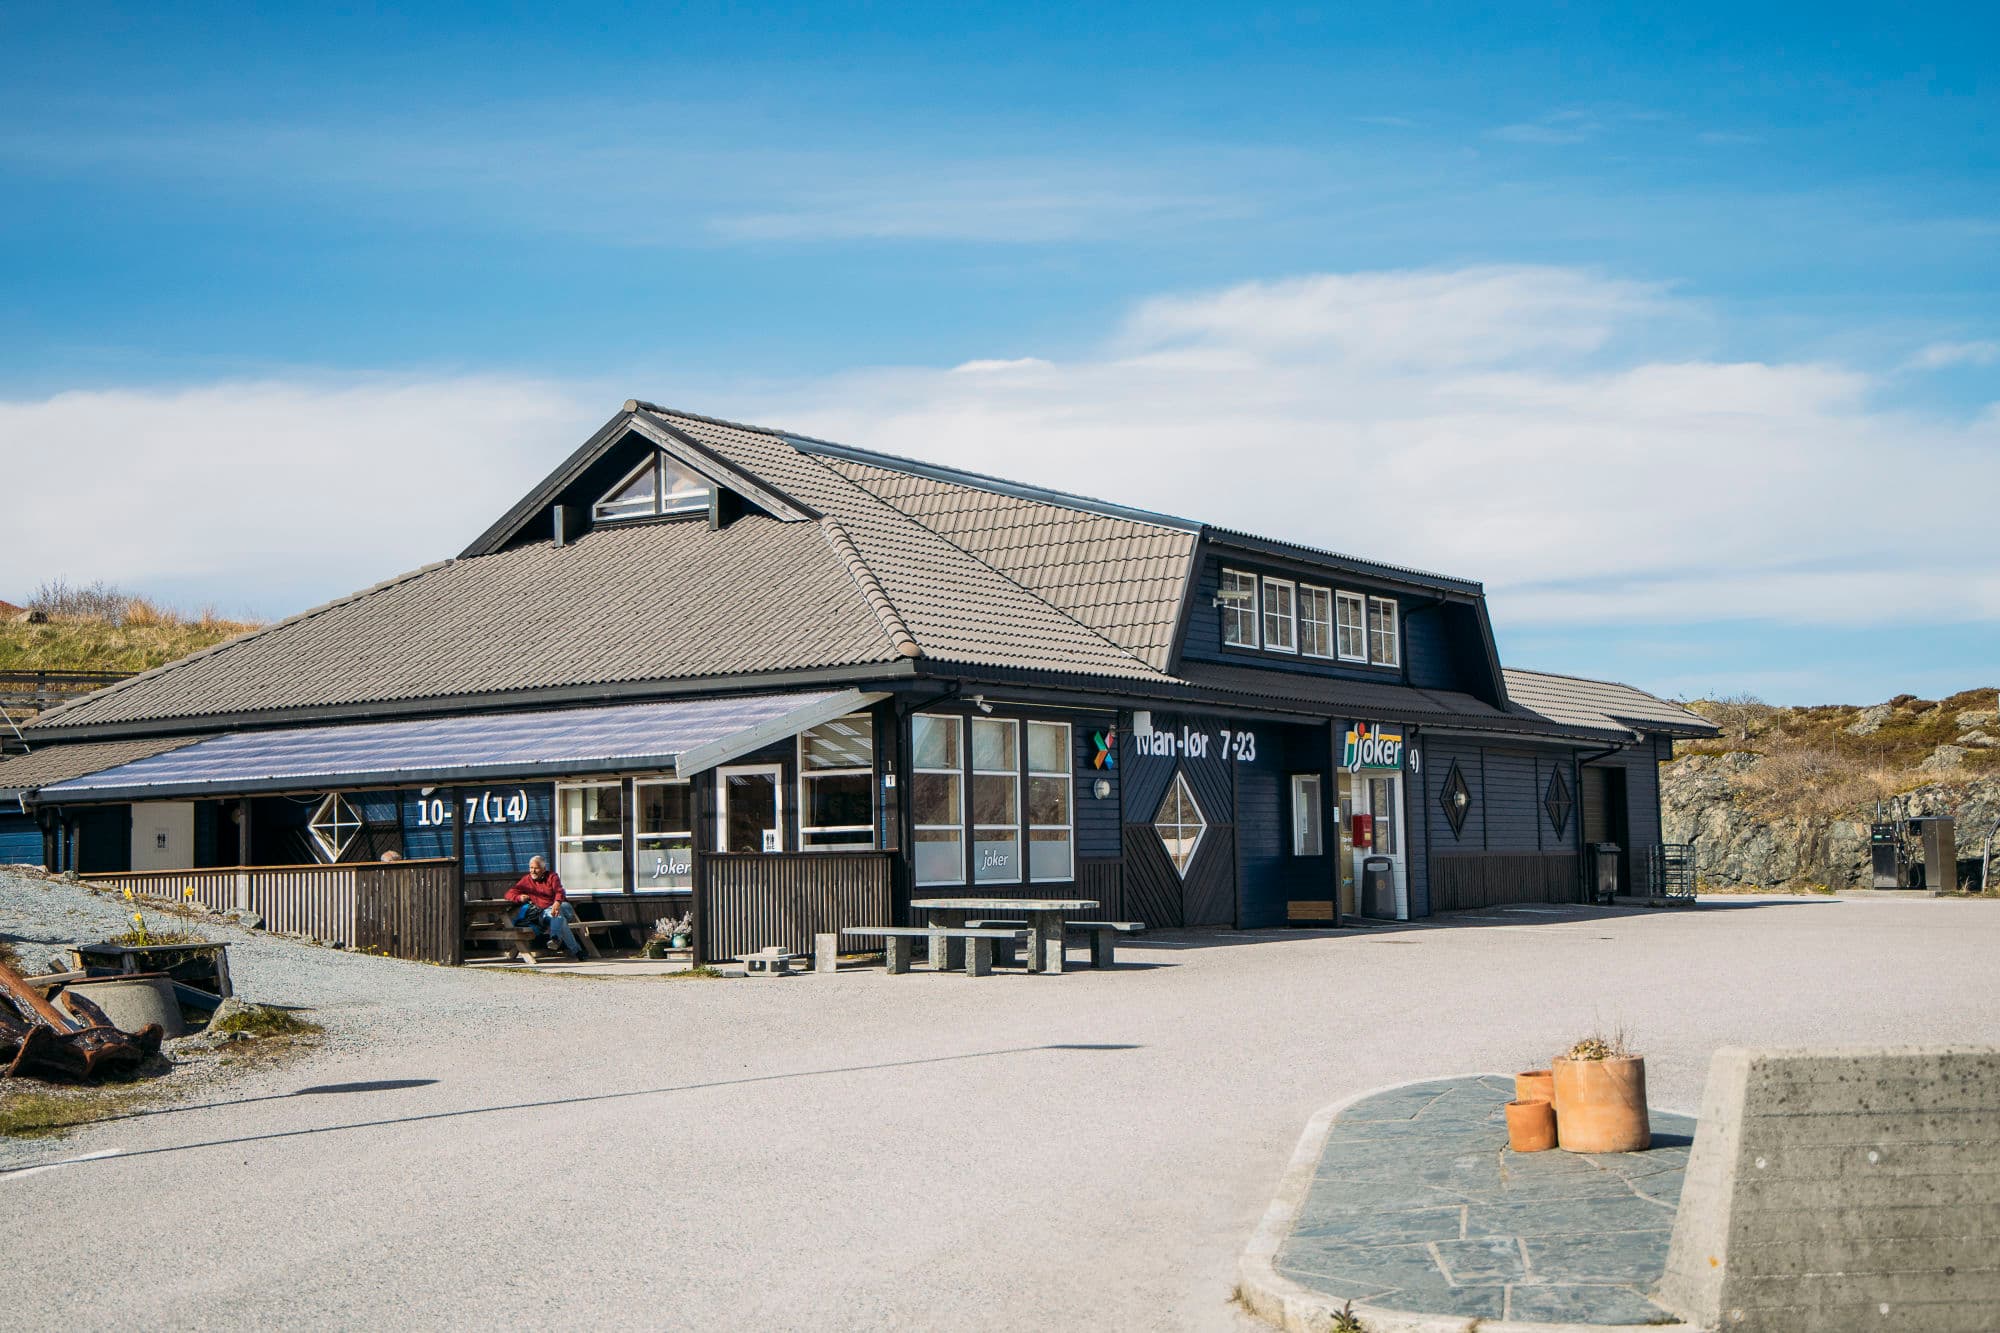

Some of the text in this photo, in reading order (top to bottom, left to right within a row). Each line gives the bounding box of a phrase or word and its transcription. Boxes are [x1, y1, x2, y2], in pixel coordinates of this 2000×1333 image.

[1351, 722, 1402, 774] joker
[652, 857, 691, 879] joker
[982, 849, 1009, 871] joker
